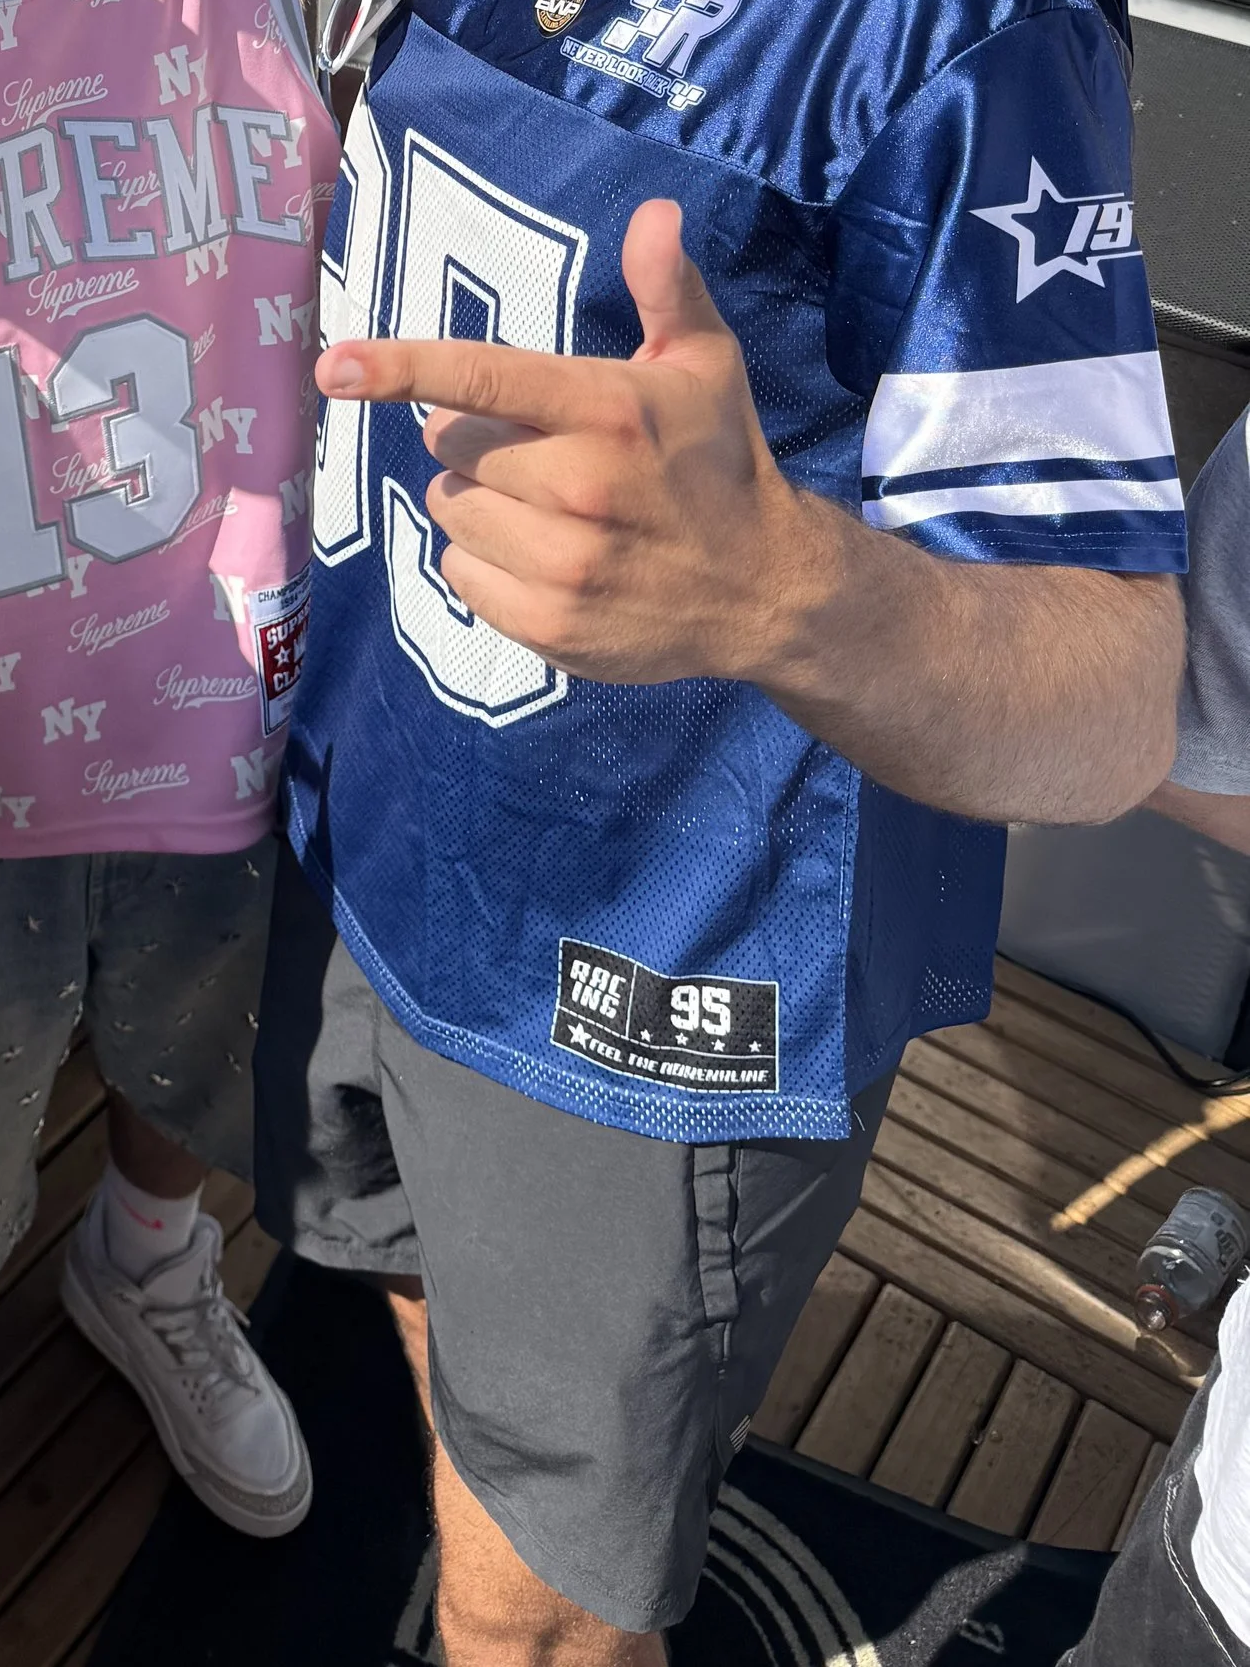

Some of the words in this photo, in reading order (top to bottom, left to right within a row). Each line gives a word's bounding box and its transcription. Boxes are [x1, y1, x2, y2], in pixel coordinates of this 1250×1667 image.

[562, 38, 607, 69] NEVER
[606, 56, 650, 85] LOOK
[2, 73, 108, 128] Supreme
[186, 234, 230, 287] NY
[26, 267, 140, 324] Supreme
[198, 396, 258, 455] NY
[67, 599, 171, 657] Supreme
[153, 663, 258, 711] Supreme
[40, 697, 107, 745] NY
[81, 758, 190, 804] Supreme
[569, 959, 627, 999] RAC
[571, 981, 621, 1020] ING
[670, 984, 732, 1037] 95
[589, 1037, 623, 1063] FEEL
[628, 1052, 659, 1074] THE
